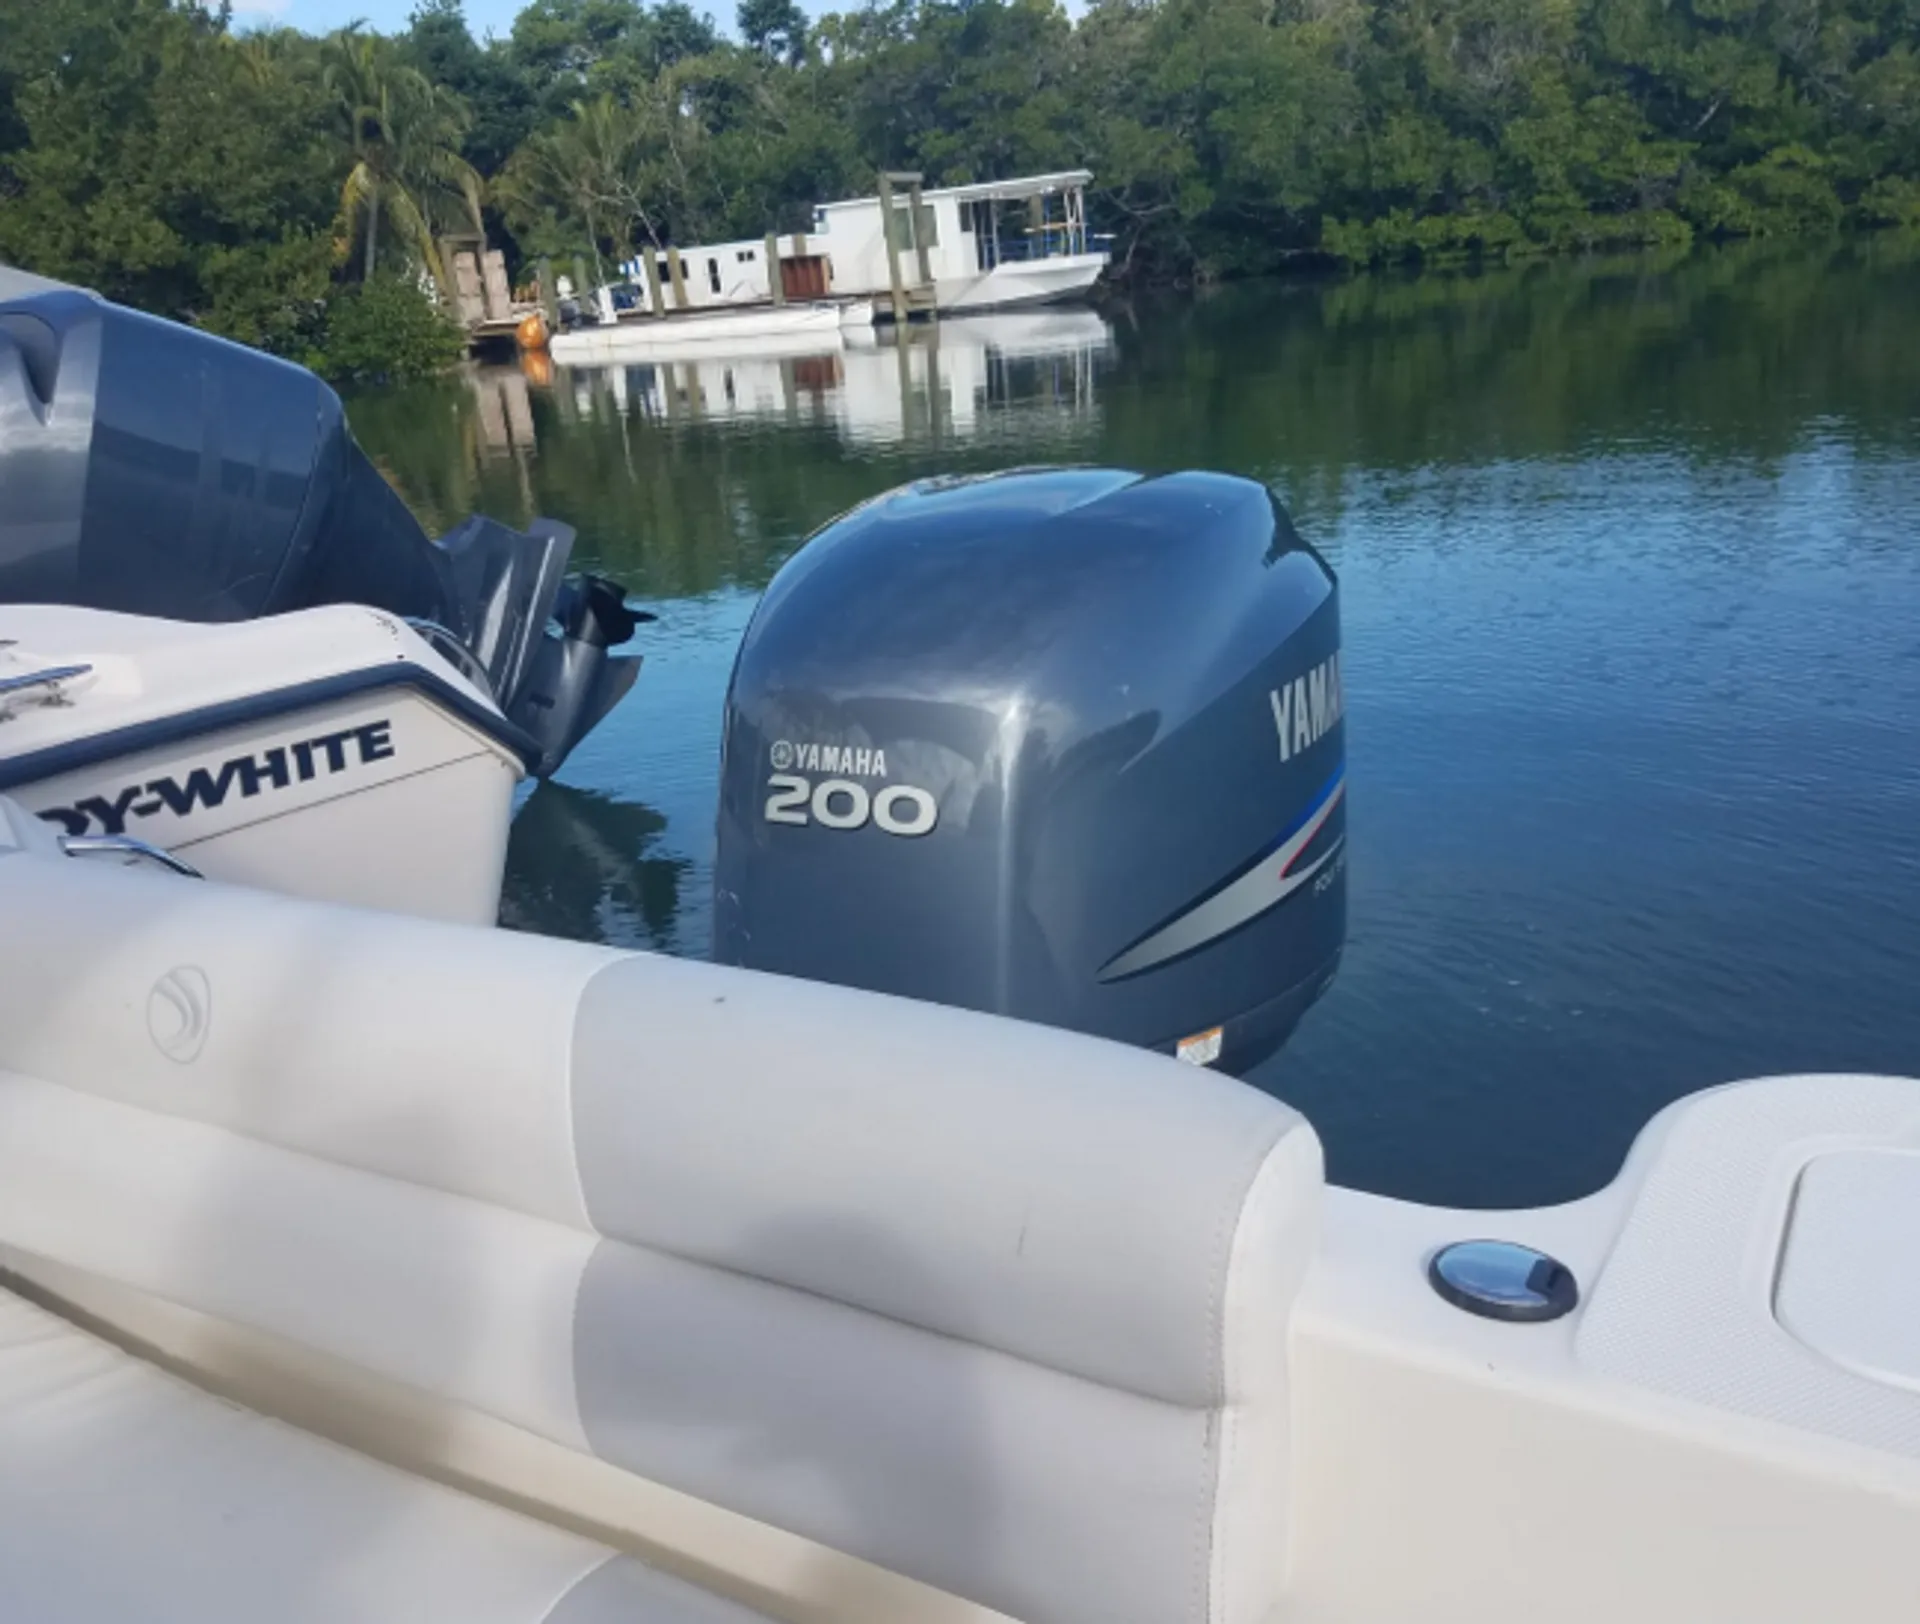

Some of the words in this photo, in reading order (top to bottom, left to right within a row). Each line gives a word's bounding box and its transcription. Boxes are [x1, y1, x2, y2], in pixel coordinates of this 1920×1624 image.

[1270, 650, 1341, 763] YAMA
[795, 743, 888, 778] YAMAHA
[764, 773, 938, 836] 200
